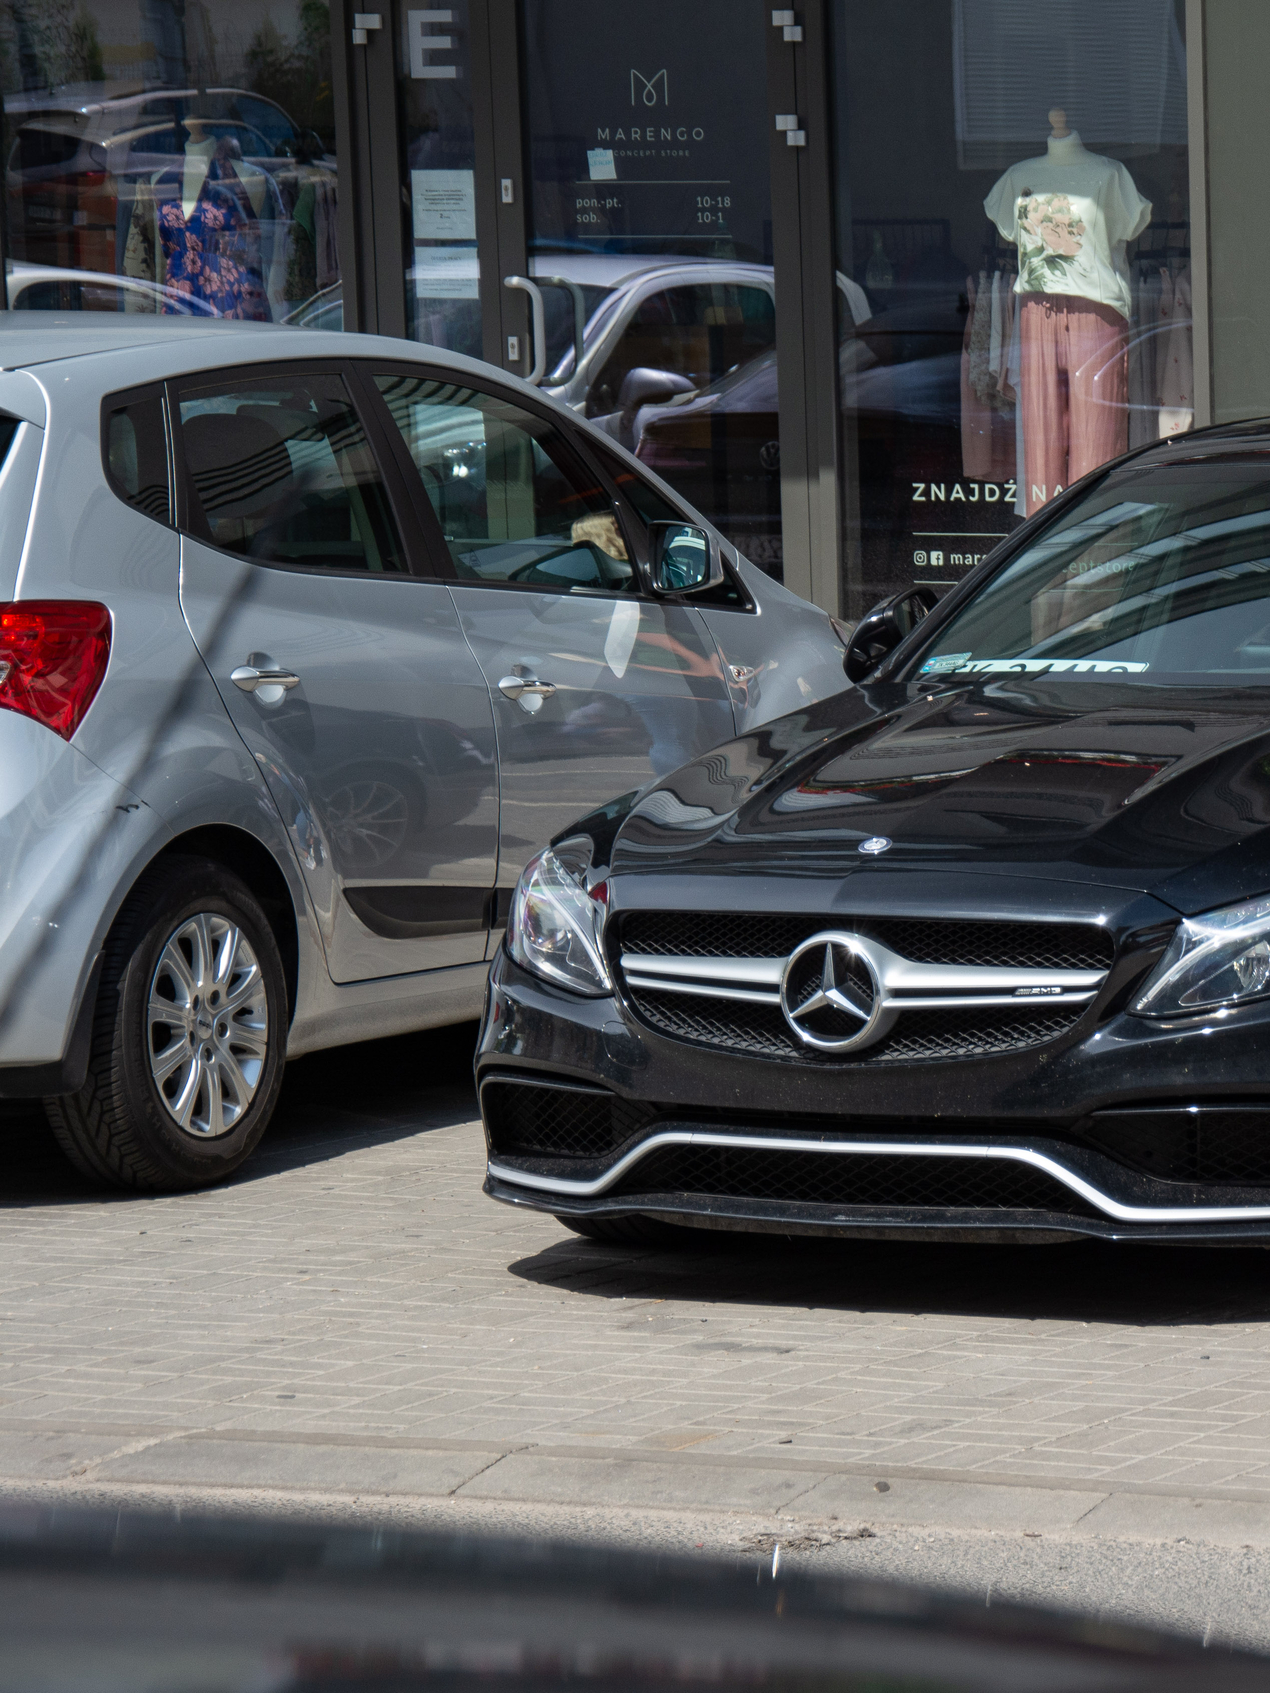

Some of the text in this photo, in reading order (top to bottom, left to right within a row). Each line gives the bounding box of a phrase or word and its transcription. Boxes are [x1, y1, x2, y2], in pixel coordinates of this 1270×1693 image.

[407, 9, 457, 79] E
[597, 127, 704, 141] MARENGO
[576, 196, 731, 209] pon.-pt. 10-18
[576, 211, 601, 223] sob.
[912, 479, 1017, 502] ZNAJDŹ
